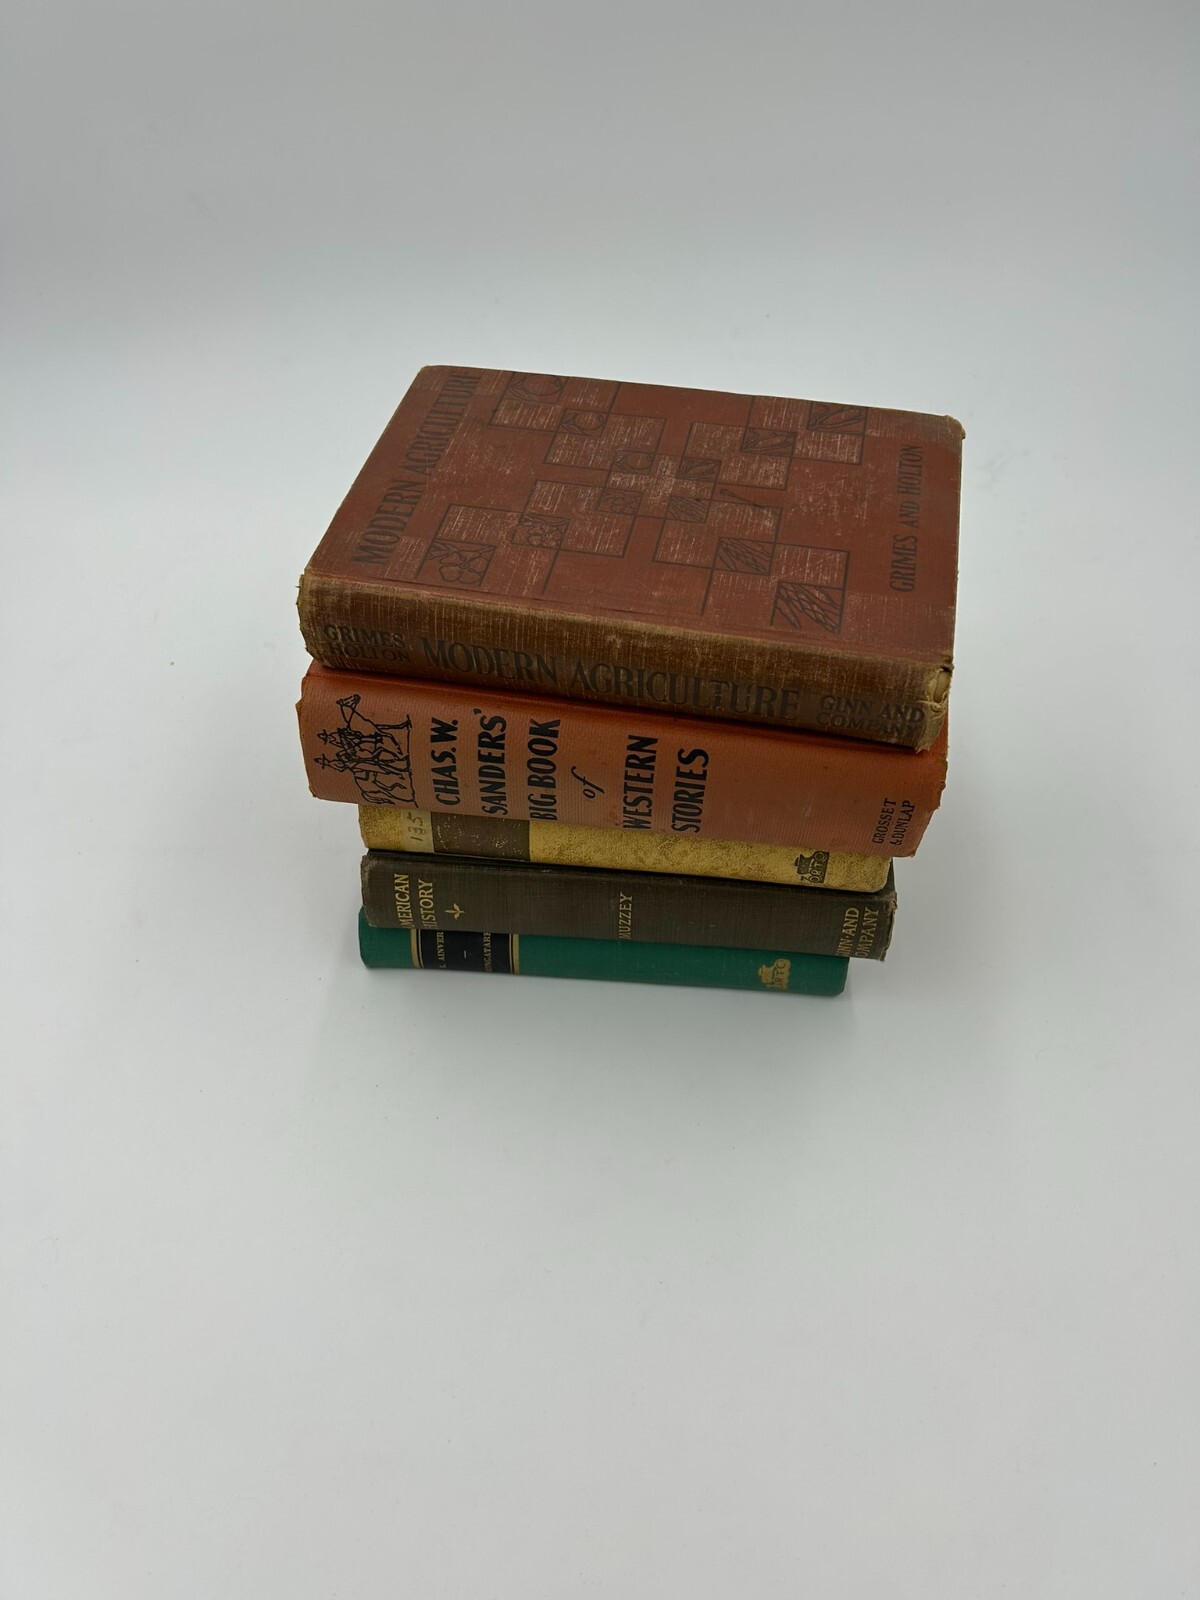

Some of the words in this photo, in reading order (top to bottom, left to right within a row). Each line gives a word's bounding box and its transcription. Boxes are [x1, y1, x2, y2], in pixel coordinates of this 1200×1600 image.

[352, 479, 425, 565] MODERN
[401, 371, 482, 476] AGRICULTURE
[897, 444, 924, 496] HOLTON
[900, 502, 921, 529] AND
[889, 534, 918, 592] GRIMES
[323, 623, 405, 649] GRIMES
[419, 636, 562, 684] MODERN
[569, 656, 800, 721] AGRICULTURE
[430, 716, 459, 744] W.
[880, 702, 925, 723] AND
[430, 748, 461, 806] CHAS.
[526, 718, 561, 785] BOOK
[529, 786, 558, 821] BIG
[571, 765, 605, 799] of
[622, 734, 659, 830] WESTERN
[671, 748, 709, 833] STORIES
[871, 797, 897, 845] GROSSET
[418, 878, 438, 930] HISTORY
[618, 892, 633, 940] MUZZEY
[855, 907, 879, 957] OMPANY
